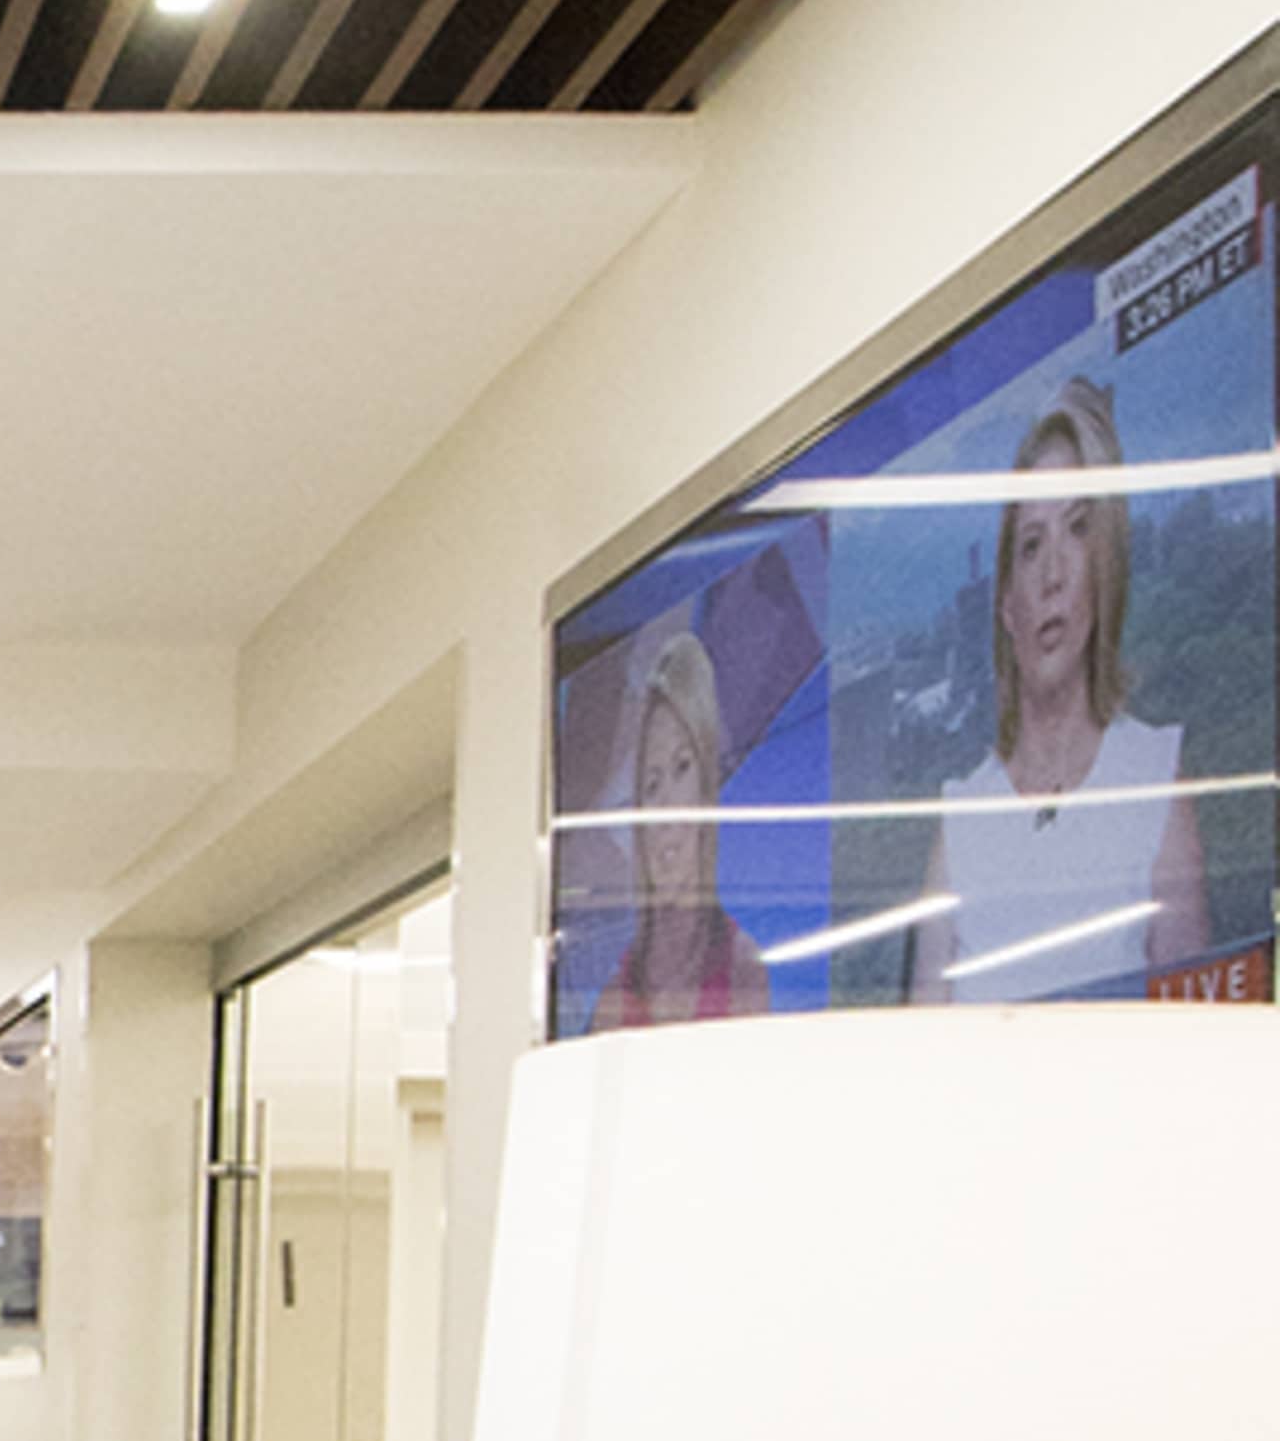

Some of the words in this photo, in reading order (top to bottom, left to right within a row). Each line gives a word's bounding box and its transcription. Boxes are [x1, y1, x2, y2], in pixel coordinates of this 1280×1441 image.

[1108, 192, 1244, 301] Washington
[1176, 251, 1216, 306] PM
[1219, 227, 1250, 279] ET
